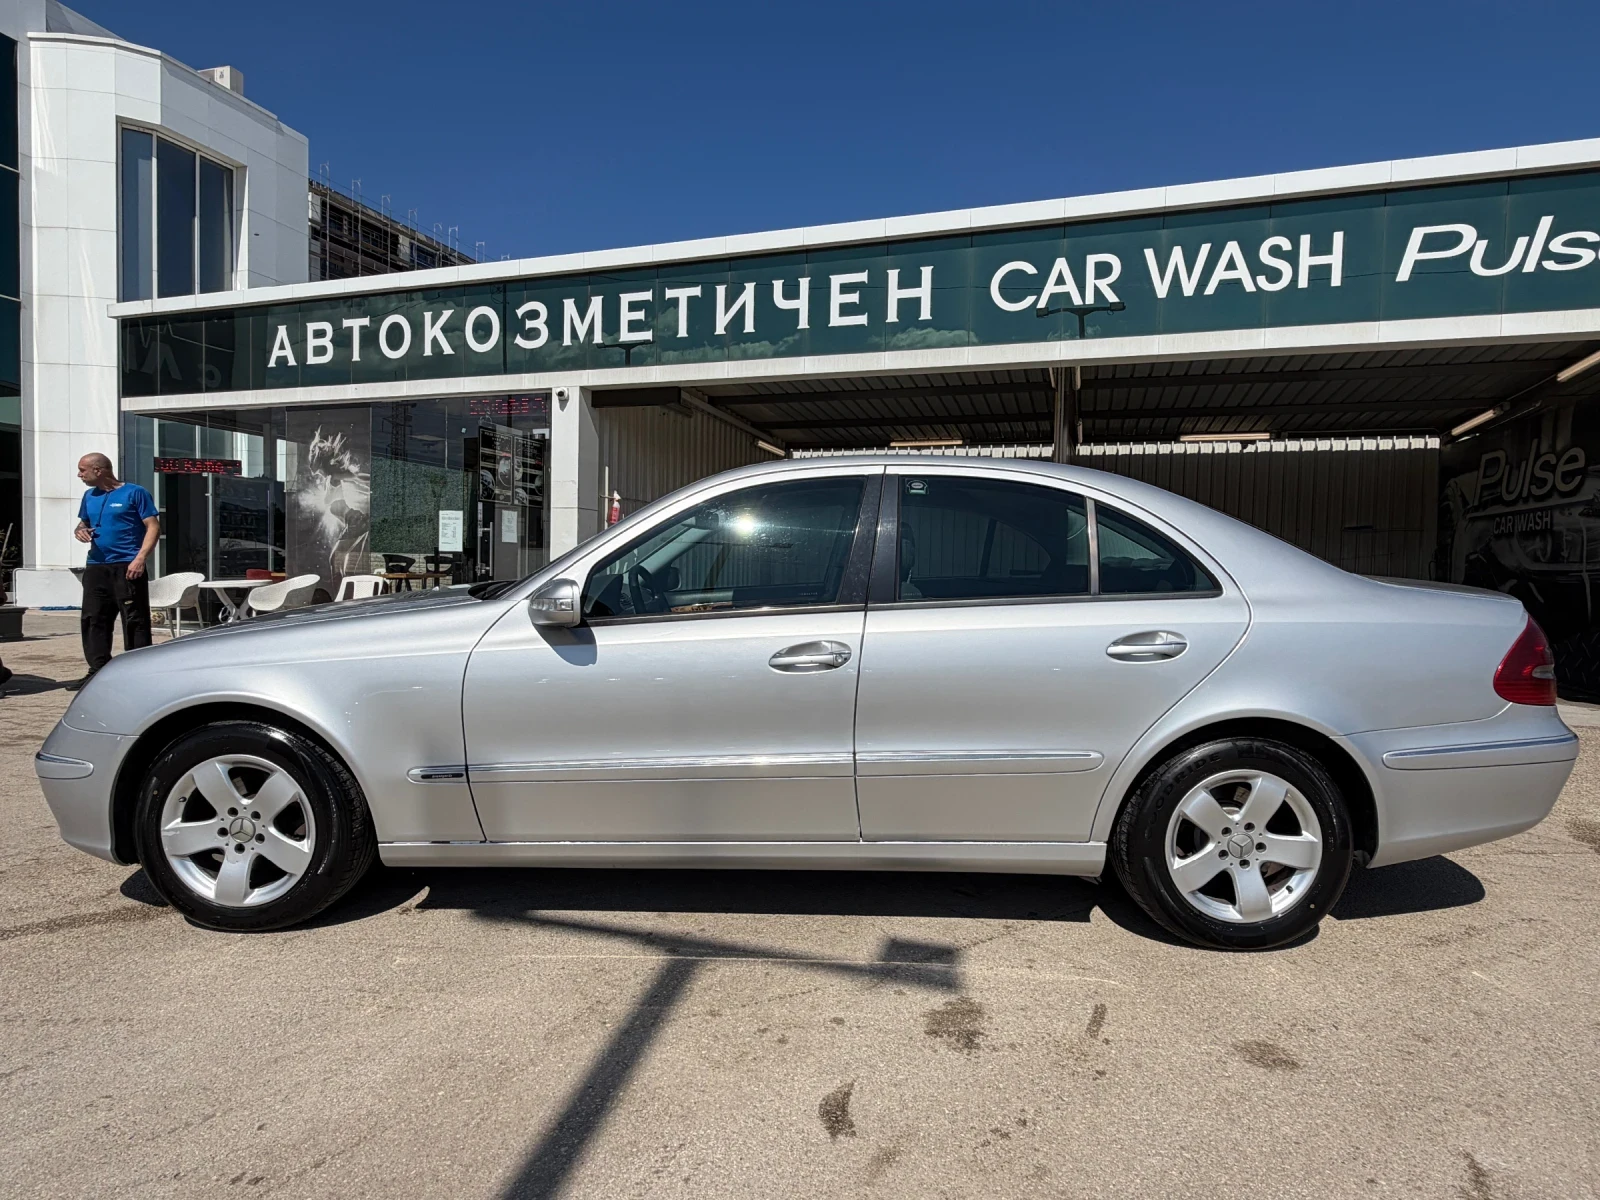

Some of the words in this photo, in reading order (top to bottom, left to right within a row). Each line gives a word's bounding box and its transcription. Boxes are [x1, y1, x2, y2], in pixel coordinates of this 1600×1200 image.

[990, 253, 1122, 312] CAR
[1143, 231, 1345, 299] WASH
[1395, 215, 1600, 282] Puls
[267, 265, 934, 368] АВТОКОЗМЕТИЧЕН
[1474, 439, 1586, 505] Pulse
[1494, 515, 1513, 534] CAR
[1517, 511, 1551, 531] WASH
